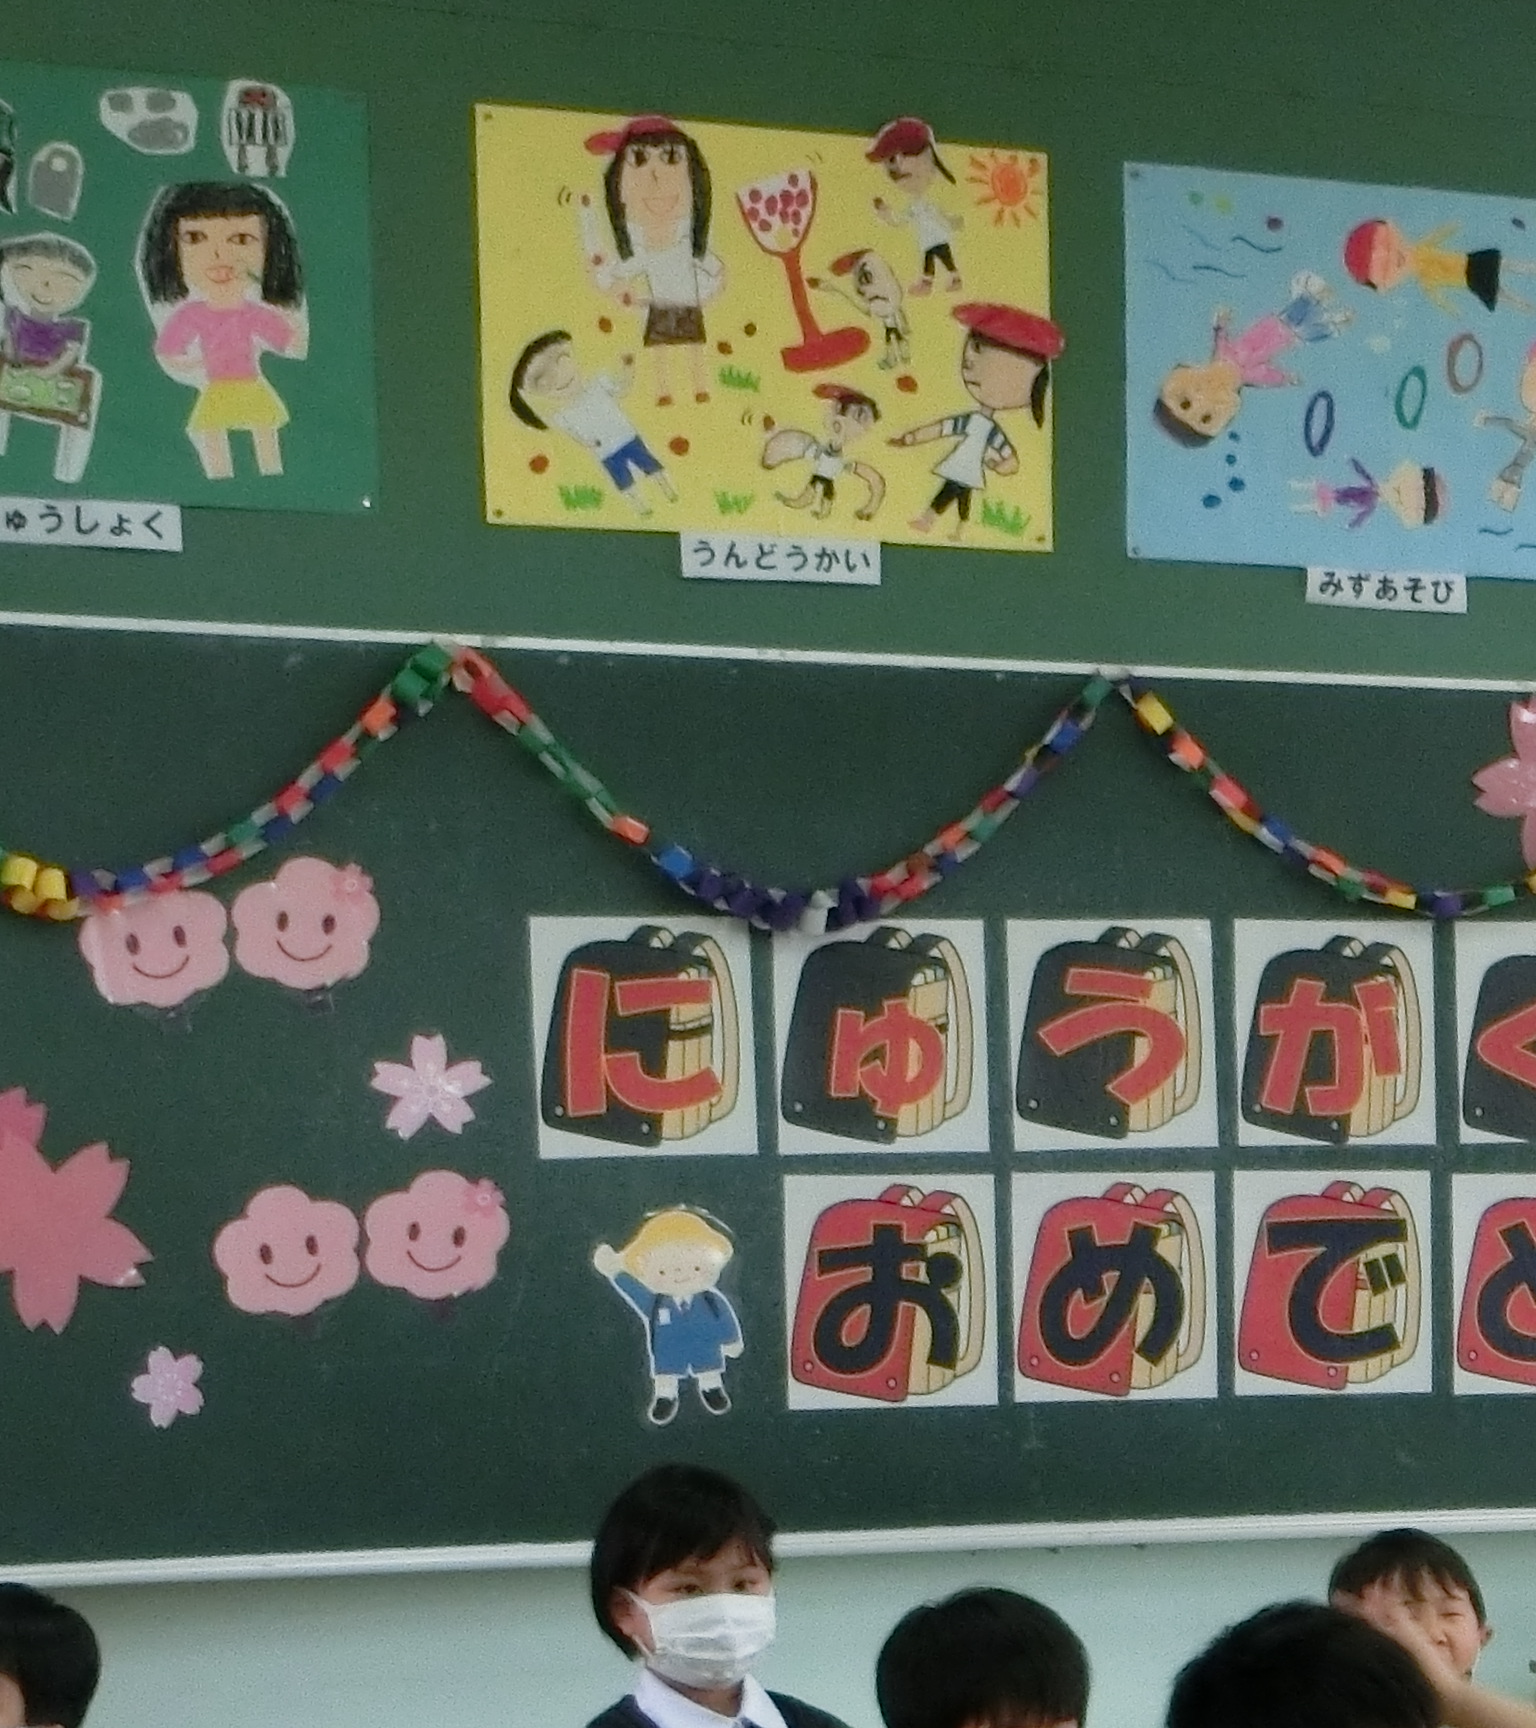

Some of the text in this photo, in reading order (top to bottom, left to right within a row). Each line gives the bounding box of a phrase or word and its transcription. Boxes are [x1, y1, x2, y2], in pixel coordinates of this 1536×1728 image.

[4, 504, 164, 540] ゅうしょく
[693, 540, 872, 574] うんどうかい
[1318, 571, 1456, 604] みずあそび
